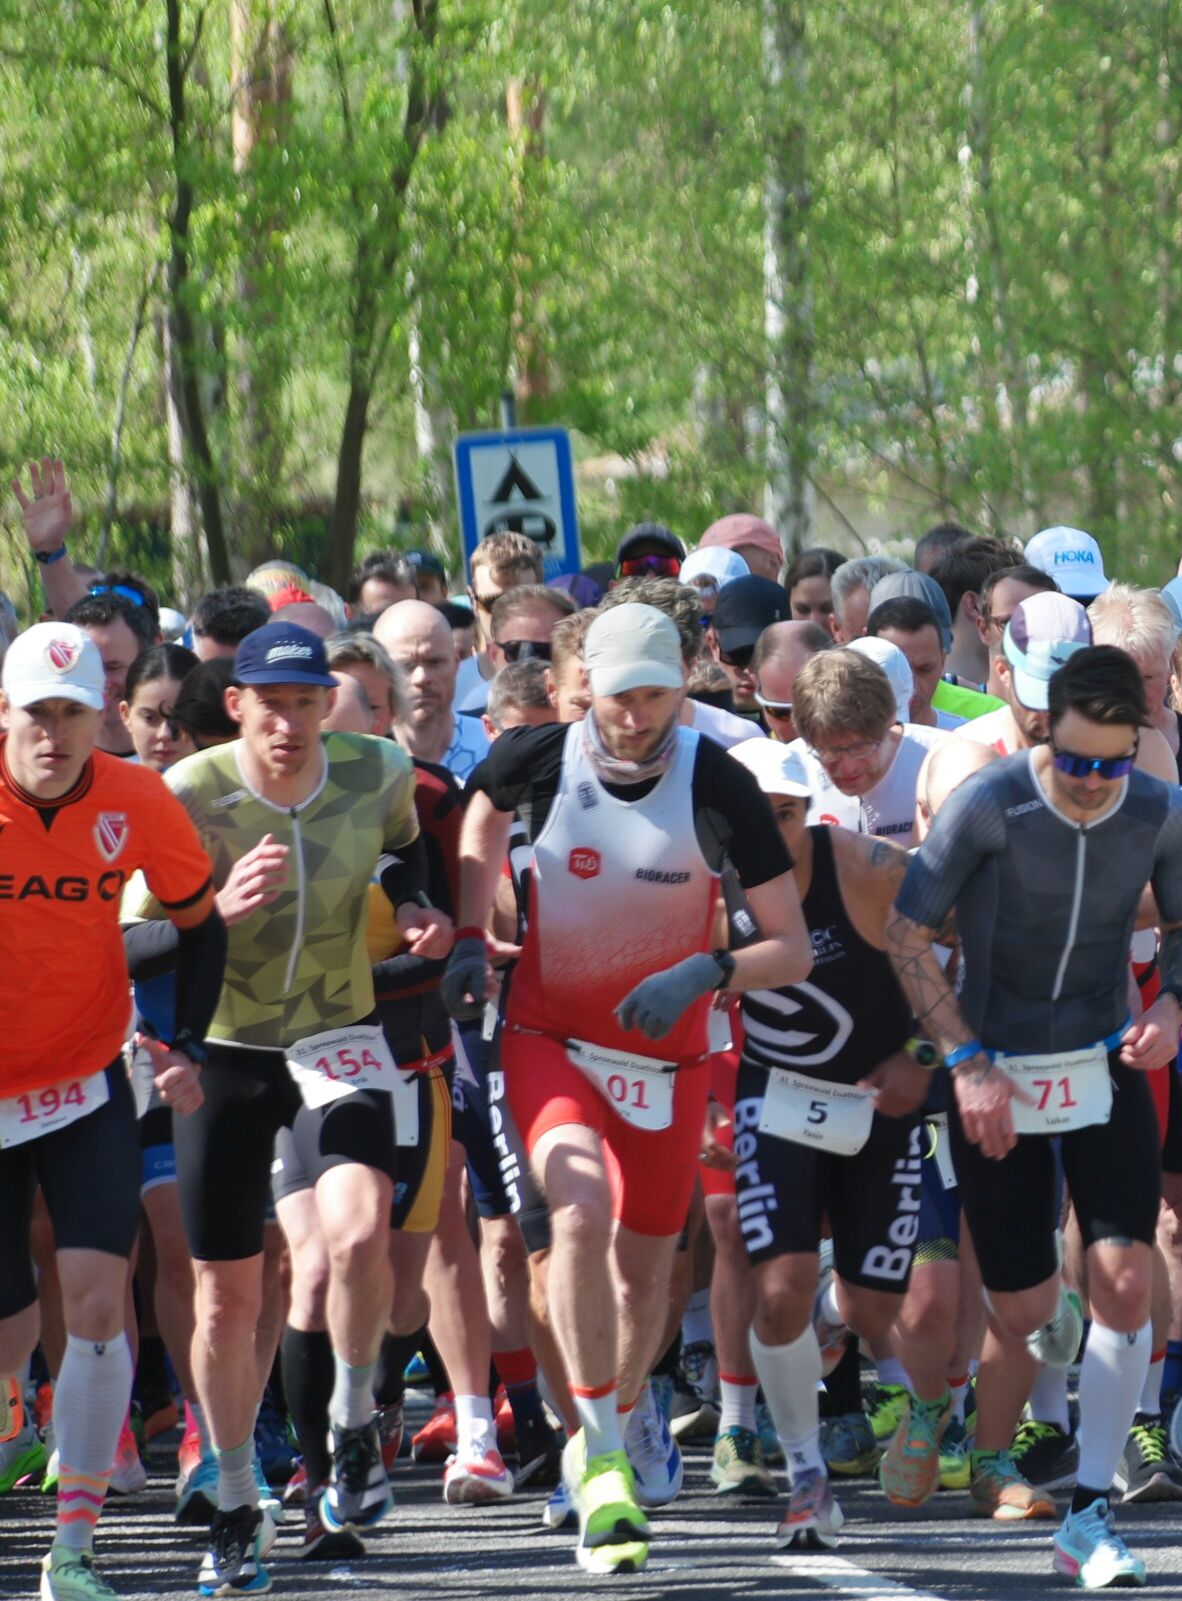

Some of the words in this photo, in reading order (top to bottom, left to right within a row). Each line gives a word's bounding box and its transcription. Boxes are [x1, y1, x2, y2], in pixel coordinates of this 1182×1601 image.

[1054, 550, 1094, 564] HOKA
[1007, 799, 1043, 816] FUSION
[635, 868, 691, 884] BIORACER
[315, 1048, 383, 1080] 154
[17, 1082, 86, 1123] 194
[1032, 1077, 1077, 1110] 71
[806, 1099, 828, 1125] 5
[733, 1096, 778, 1253] Berlin
